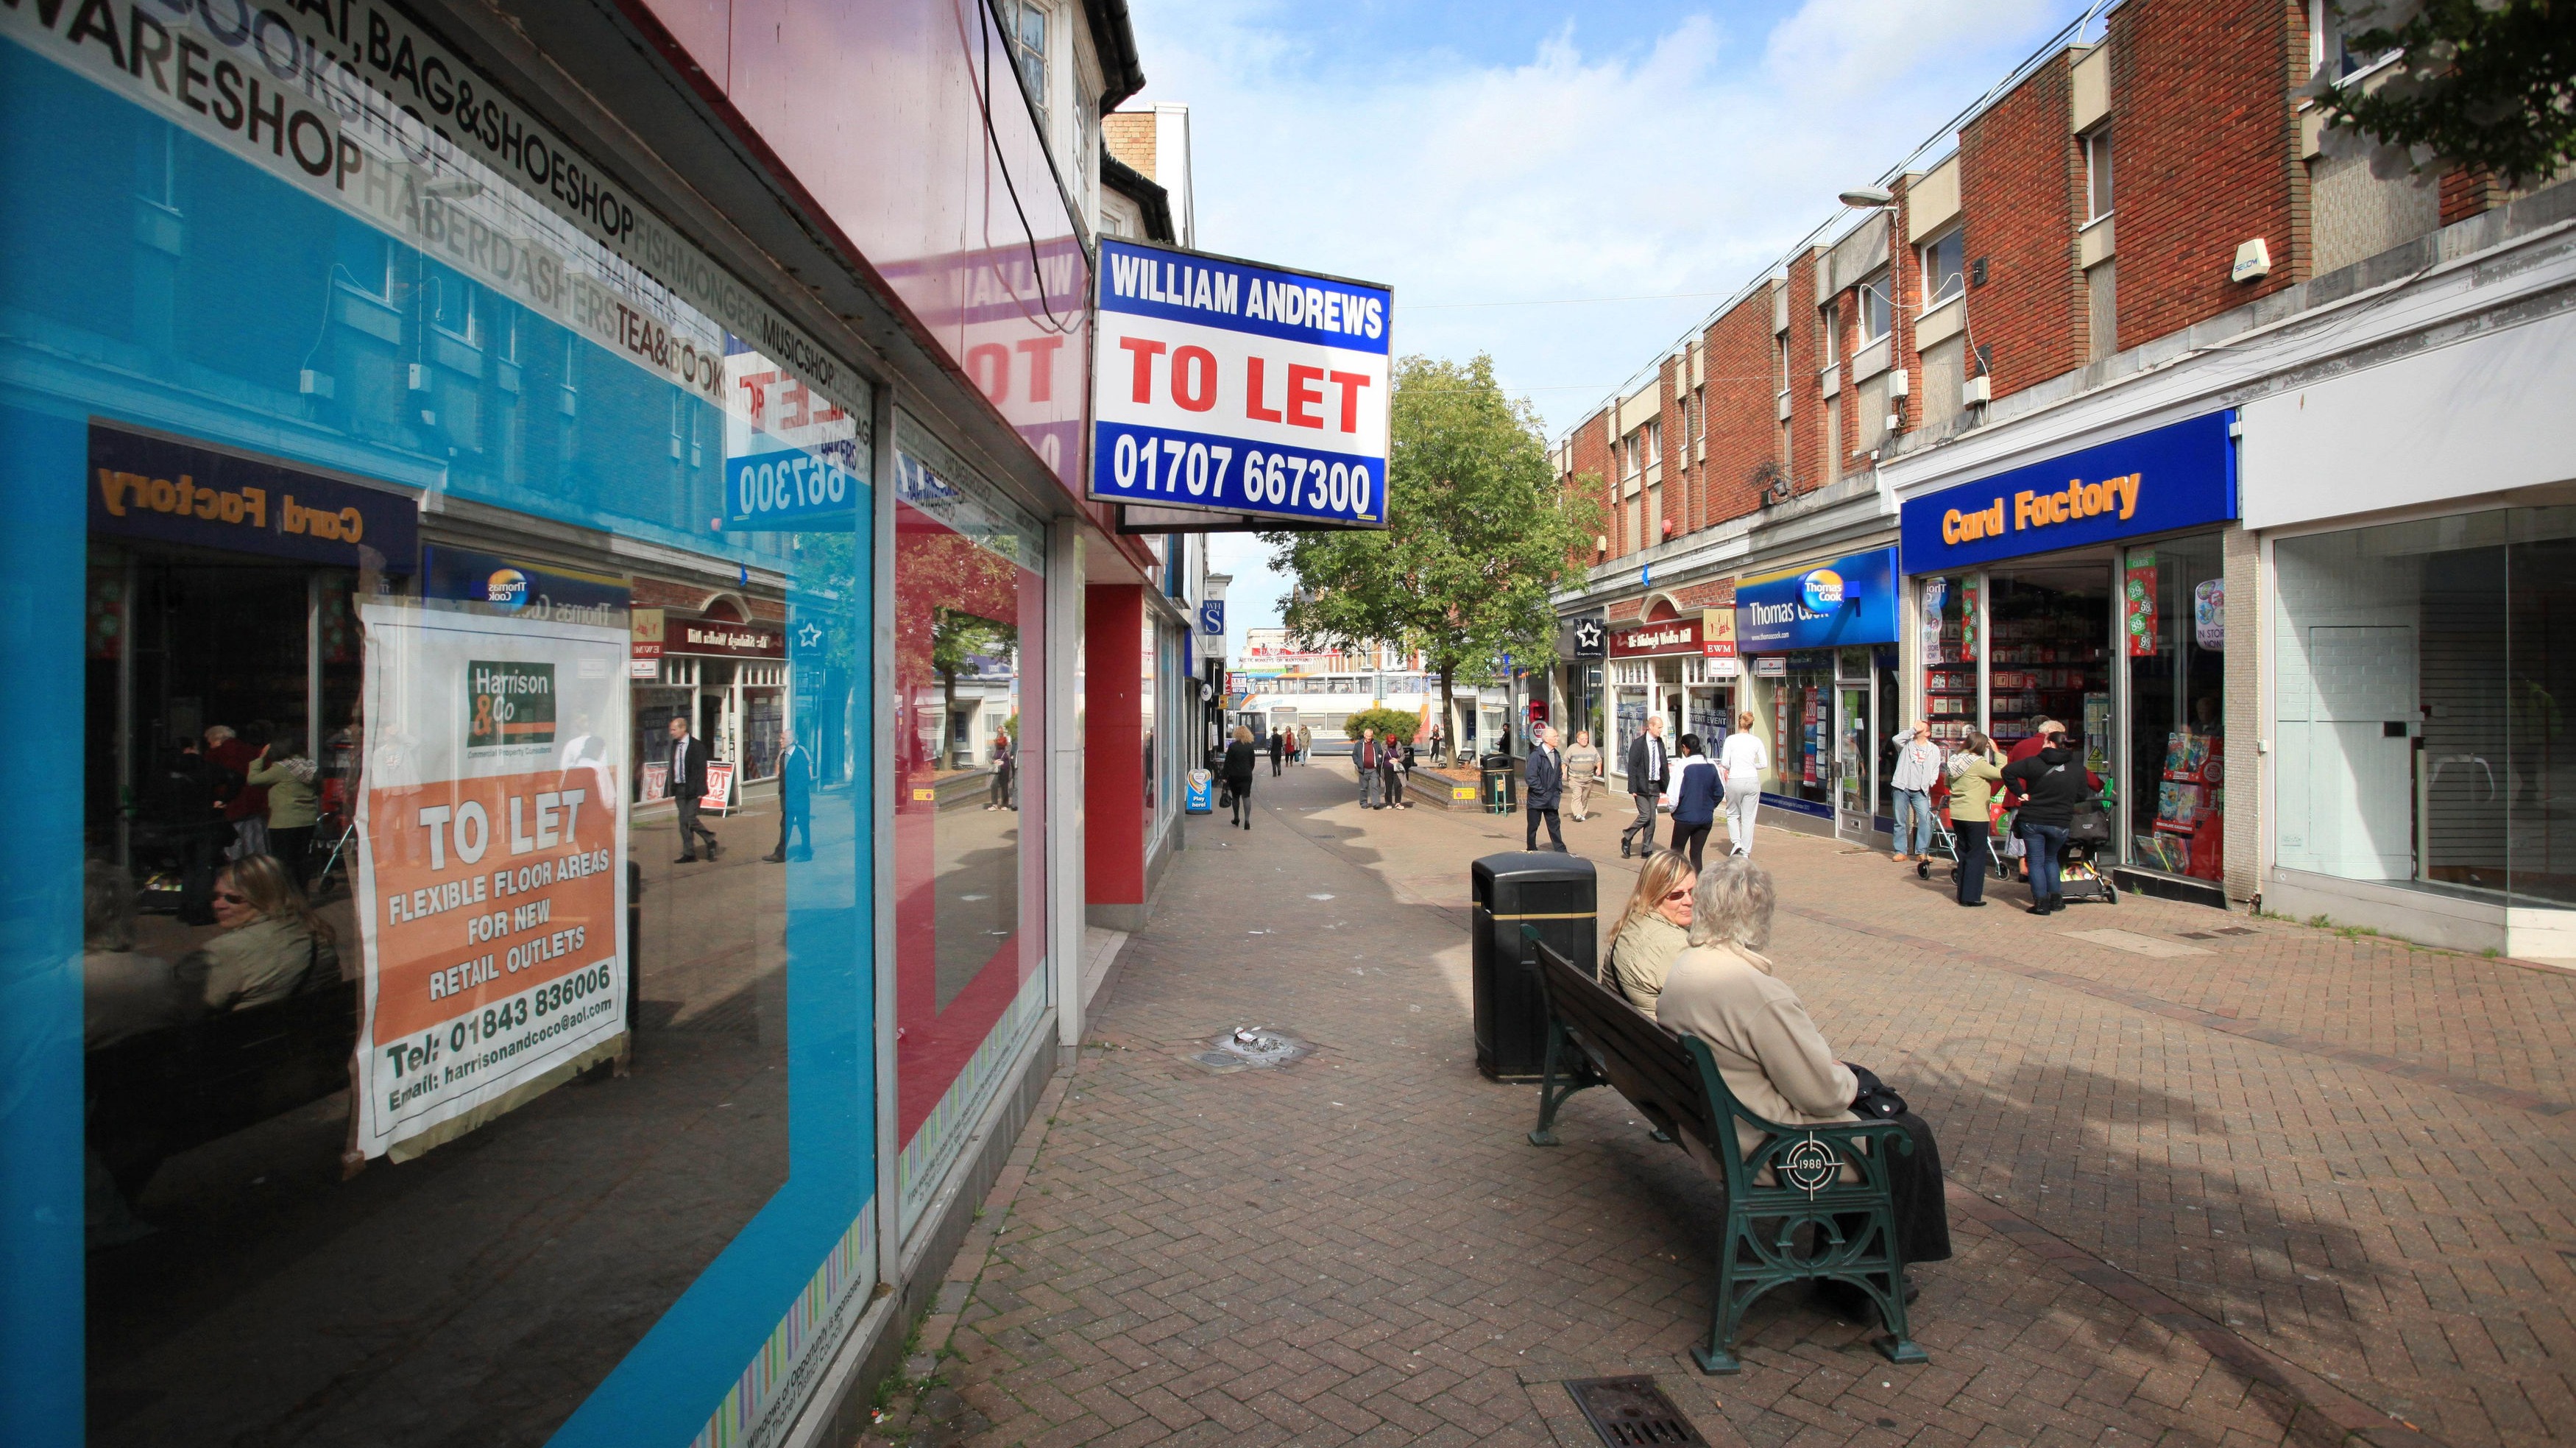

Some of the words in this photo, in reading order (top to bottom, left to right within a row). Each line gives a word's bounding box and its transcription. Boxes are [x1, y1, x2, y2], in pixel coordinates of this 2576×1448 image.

[1111, 253, 1237, 315] WILLIAM
[1245, 278, 1381, 339] ANDREWS
[1120, 336, 1218, 412] TO
[1246, 356, 1370, 434] LET
[1114, 434, 1232, 497] 01707
[1244, 450, 1370, 515] 667300
[1942, 498, 2003, 545] Card
[2014, 473, 2141, 531] Factory
[1749, 601, 1794, 626] Thomas
[1805, 582, 1842, 592] Thomas
[1819, 591, 1842, 601] Cook
[1206, 610, 1222, 633] S
[1707, 645, 1732, 653] EWM
[1751, 632, 1790, 640] www.thomascook.com
[2207, 629, 2224, 638] STOR
[476, 668, 548, 693] Harrison
[1707, 716, 1727, 725] EVENT
[419, 799, 489, 870] TO
[509, 789, 584, 856] LET
[389, 869, 487, 926] FLEXIBLE
[493, 862, 551, 900] FLOOR
[556, 848, 609, 883] AREAS
[467, 911, 507, 944] FOR
[514, 899, 551, 933] NEW
[430, 956, 500, 1002] RETAIL
[506, 925, 585, 971] OUTLETS
[386, 1035, 440, 1080] Tel:
[450, 993, 528, 1048] 01843
[534, 963, 612, 1017] 836006
[388, 1073, 440, 1112] Email:
[444, 997, 612, 1085] harrisonandcoco@aol.com
[1800, 1159, 1822, 1170] 1988
[747, 1396, 781, 1448] Windows
[782, 1379, 791, 1402] of
[790, 1327, 828, 1389] Opportunity
[834, 1271, 861, 1322] sponsored
[772, 1394, 796, 1438] Thanet
[798, 1363, 818, 1399] District
